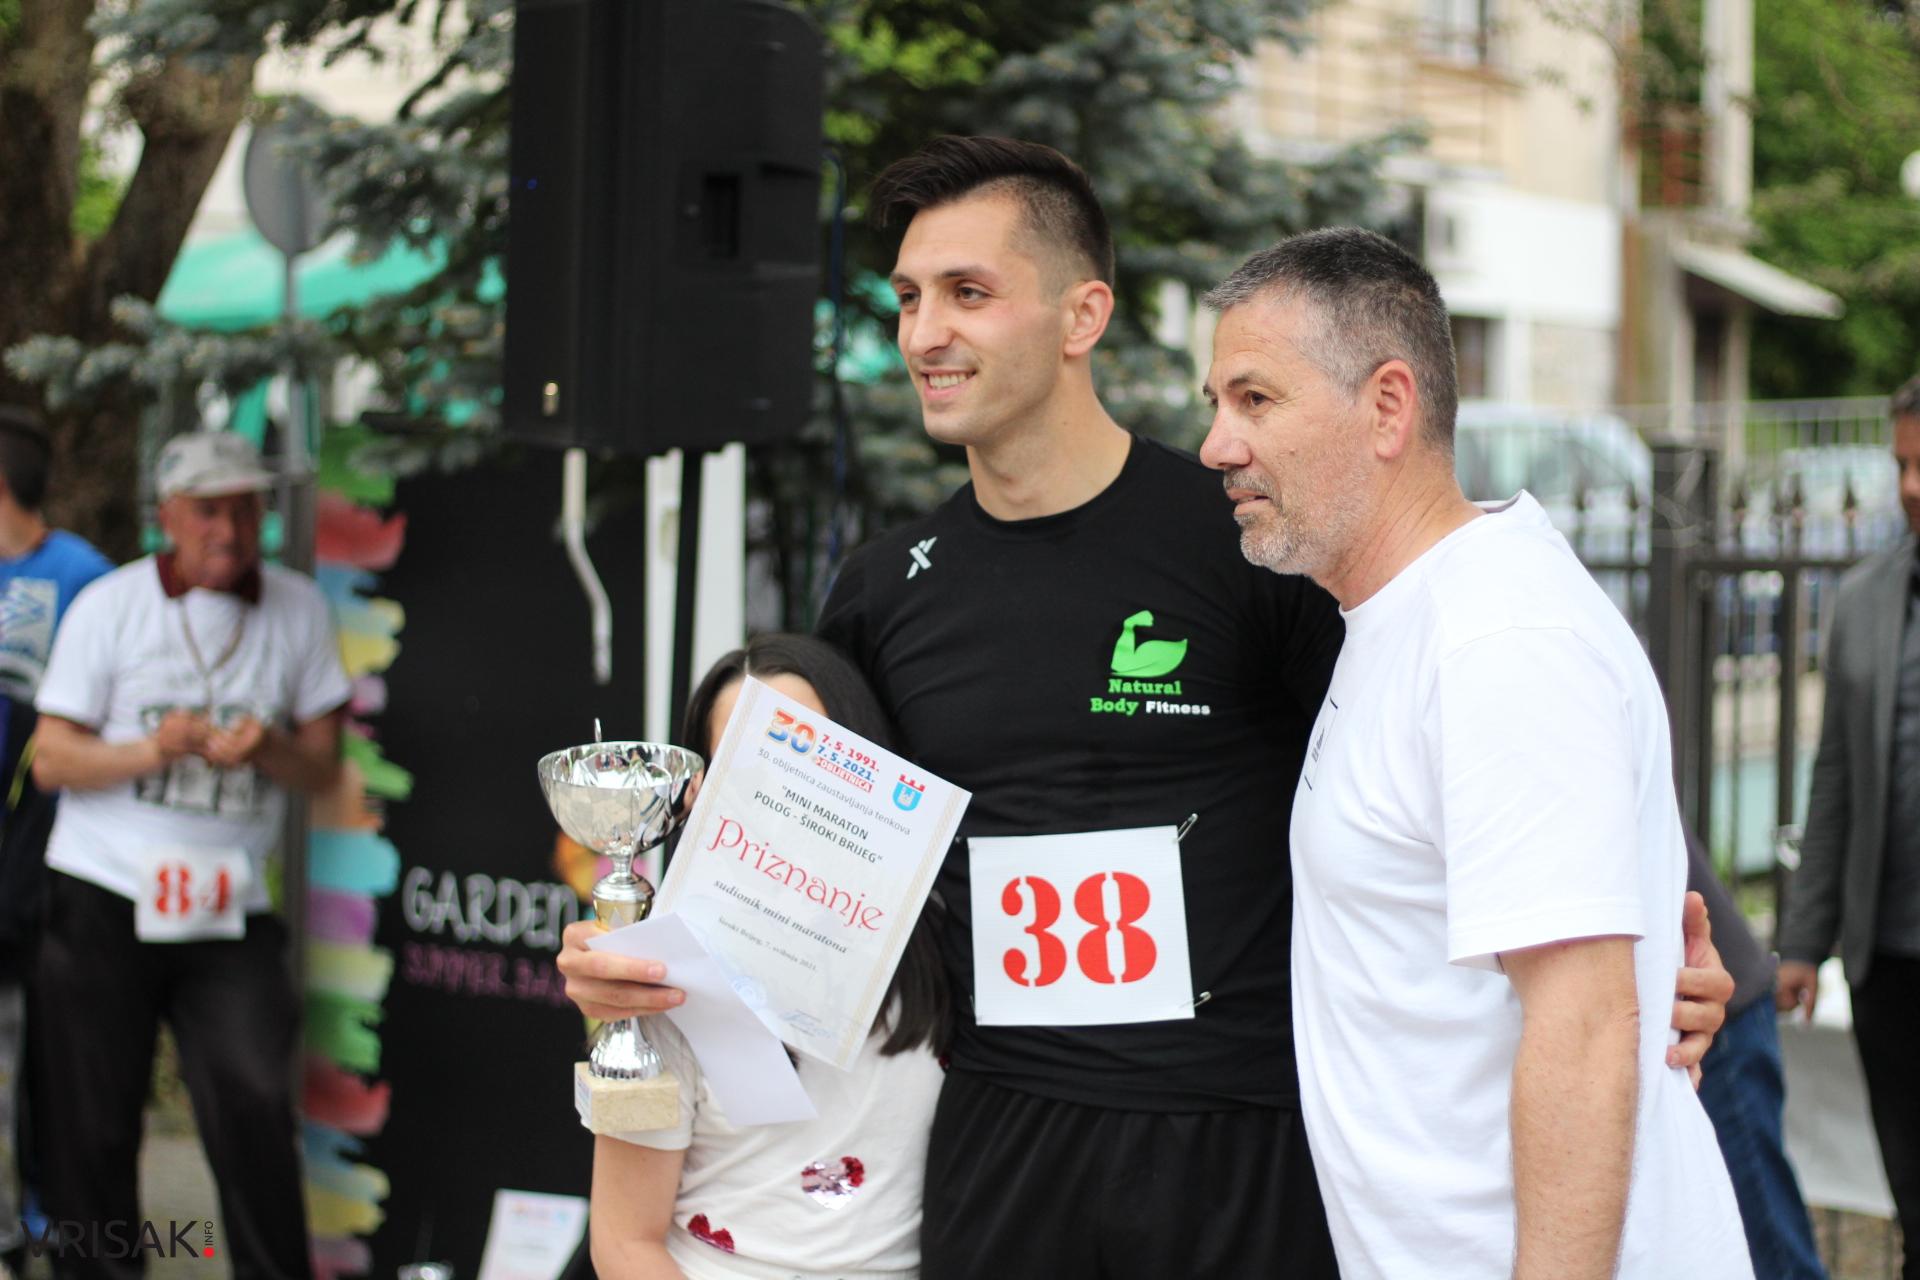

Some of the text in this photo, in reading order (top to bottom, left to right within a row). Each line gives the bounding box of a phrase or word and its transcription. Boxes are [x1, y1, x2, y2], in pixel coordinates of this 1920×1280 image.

[1090, 697, 1211, 716] Body Fitness
[1108, 679, 1182, 695] Natural
[767, 708, 816, 755] 30
[754, 790, 790, 818] POLOG
[800, 813, 837, 843] ŠIROKI
[772, 753, 816, 787] obljetnica
[816, 780, 875, 817] zaustavljanja
[875, 810, 911, 836] tenkova
[813, 803, 869, 840] MARATON
[706, 815, 885, 932] Priznanje
[402, 866, 579, 952] GARDEN
[713, 880, 848, 954] sudionik mini maratona
[1001, 871, 1158, 988] 38
